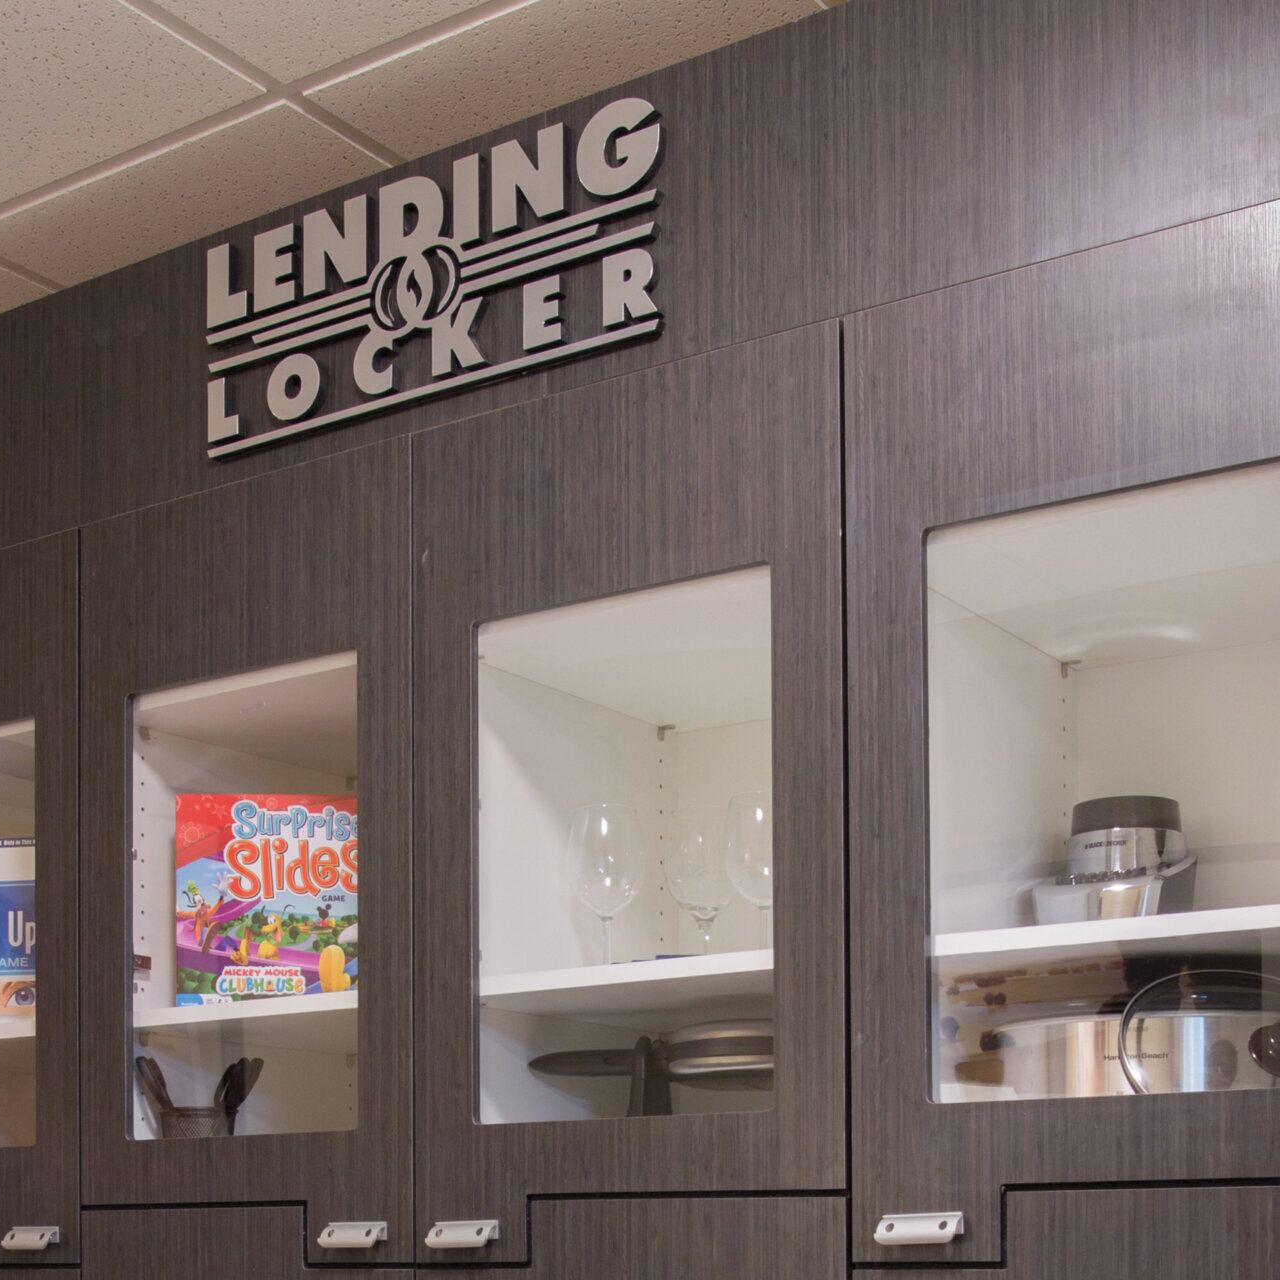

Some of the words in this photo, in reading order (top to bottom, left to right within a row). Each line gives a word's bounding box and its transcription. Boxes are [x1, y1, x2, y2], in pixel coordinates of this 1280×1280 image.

[207, 97, 661, 330] LENDING
[207, 247, 661, 443] LOCKER
[321, 895, 346, 903] GAME
[8, 910, 36, 954] Up
[219, 977, 304, 993] CLUBHOUSE
[223, 968, 262, 977] MICKEY
[264, 968, 300, 977] MOUSE
